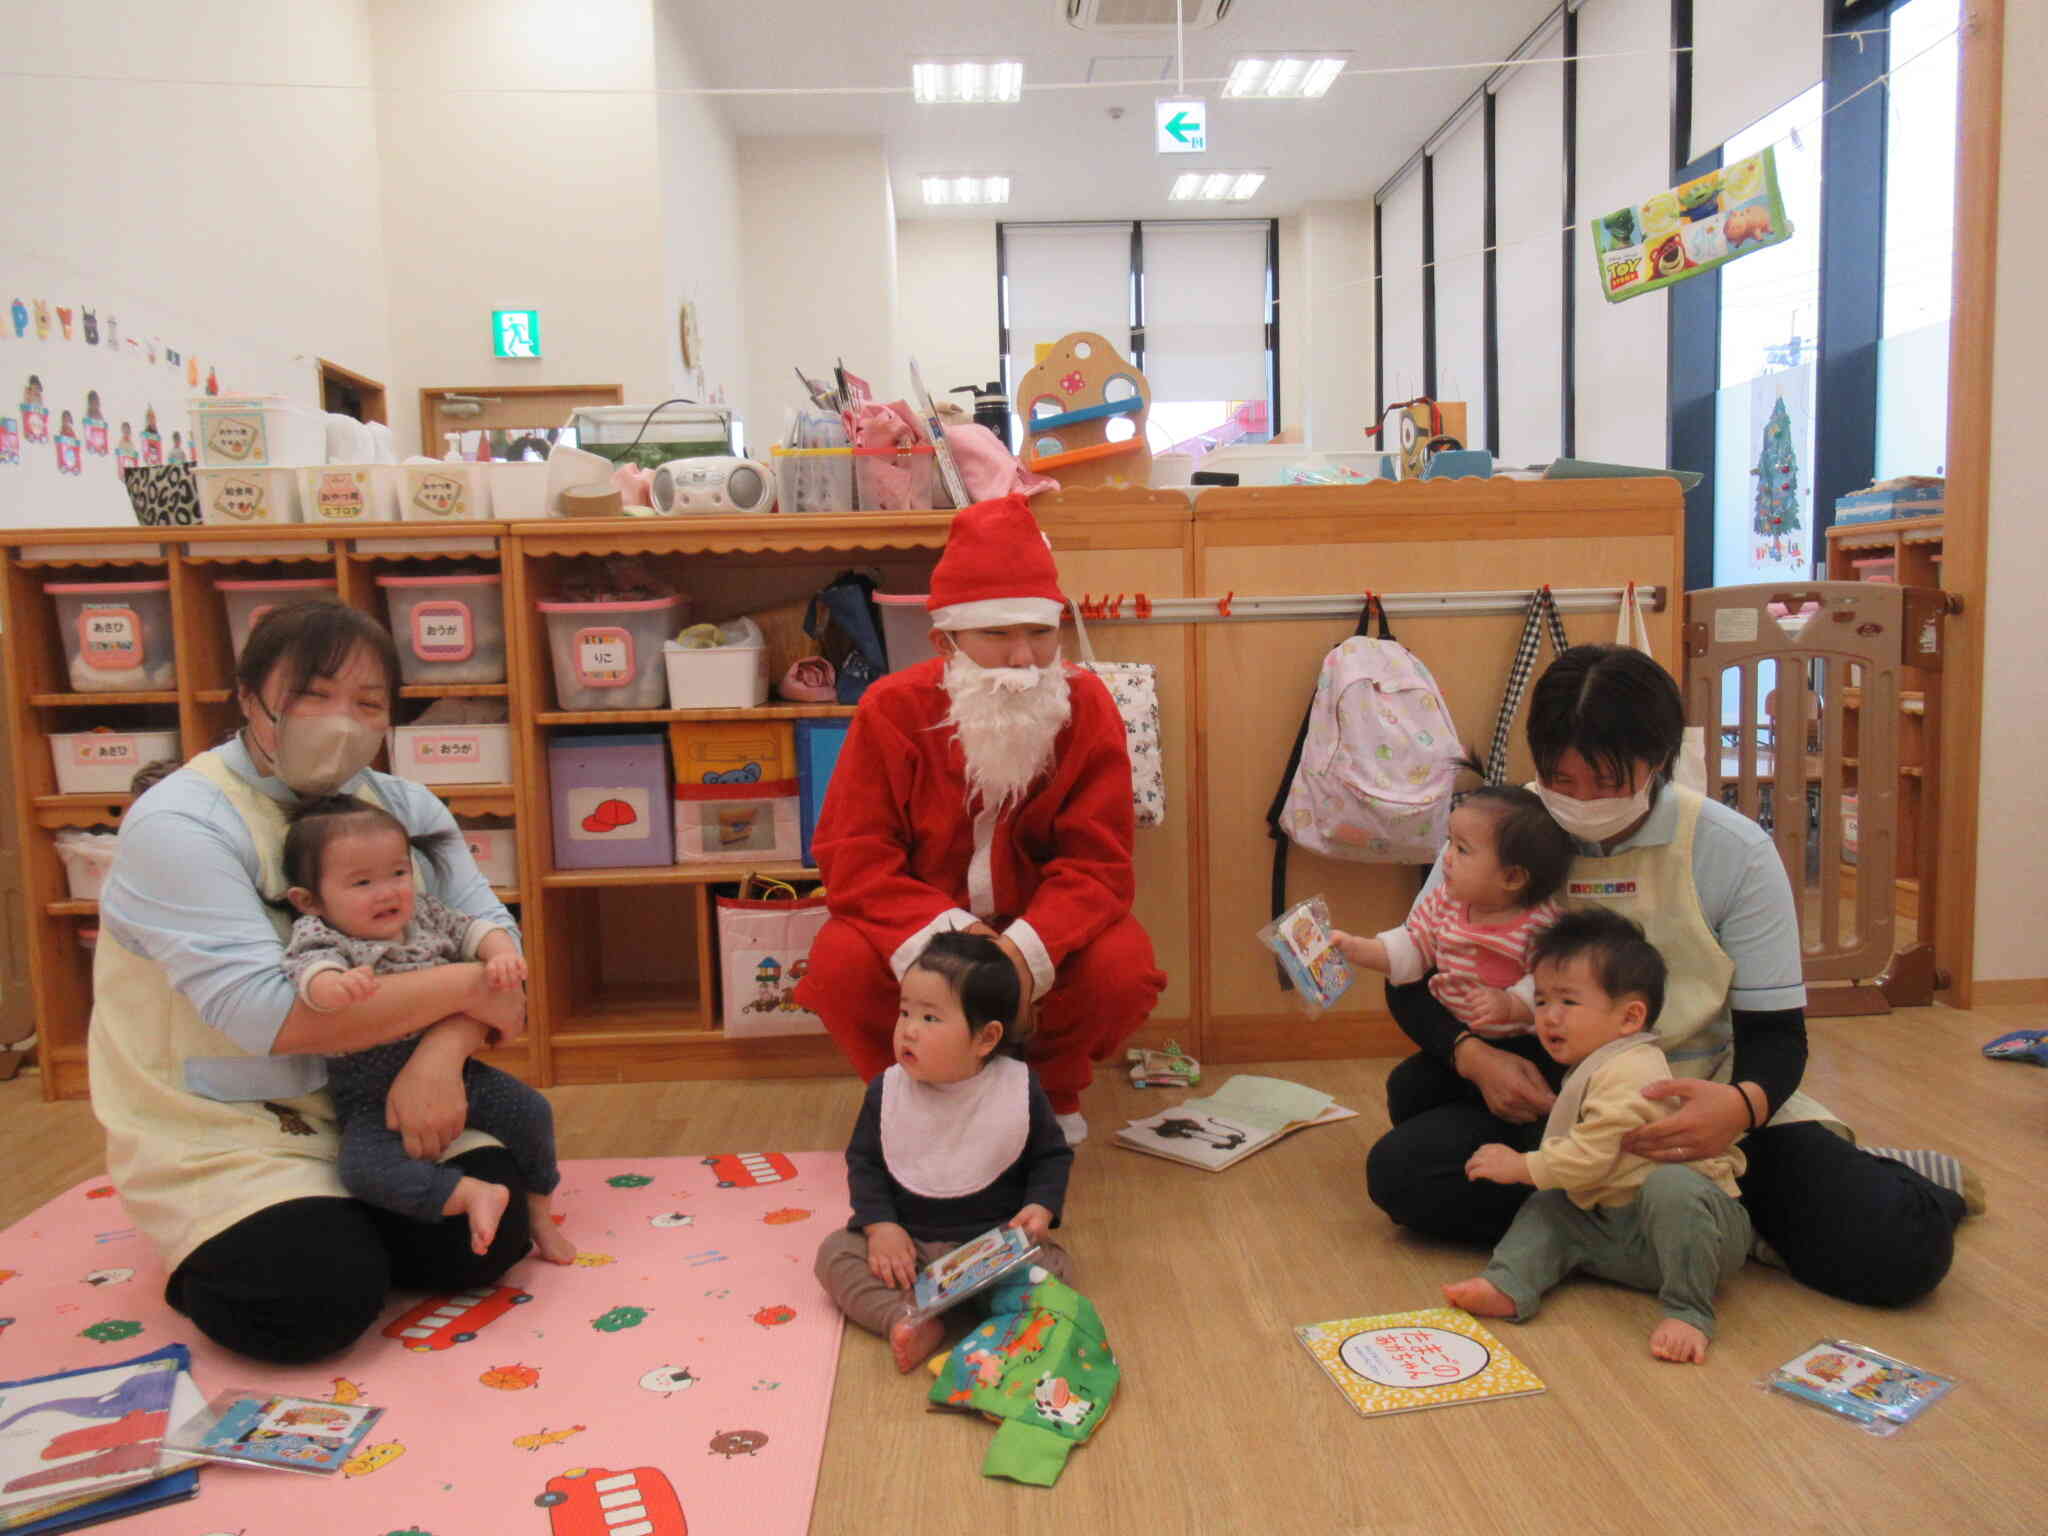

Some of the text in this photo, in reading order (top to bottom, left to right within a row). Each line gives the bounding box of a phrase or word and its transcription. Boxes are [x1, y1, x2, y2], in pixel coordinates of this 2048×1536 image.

[1607, 256, 1642, 276] TOY
[93, 622, 125, 633] あさひ
[593, 652, 613, 664] りこ
[1401, 1330, 1462, 1379] たまごの
